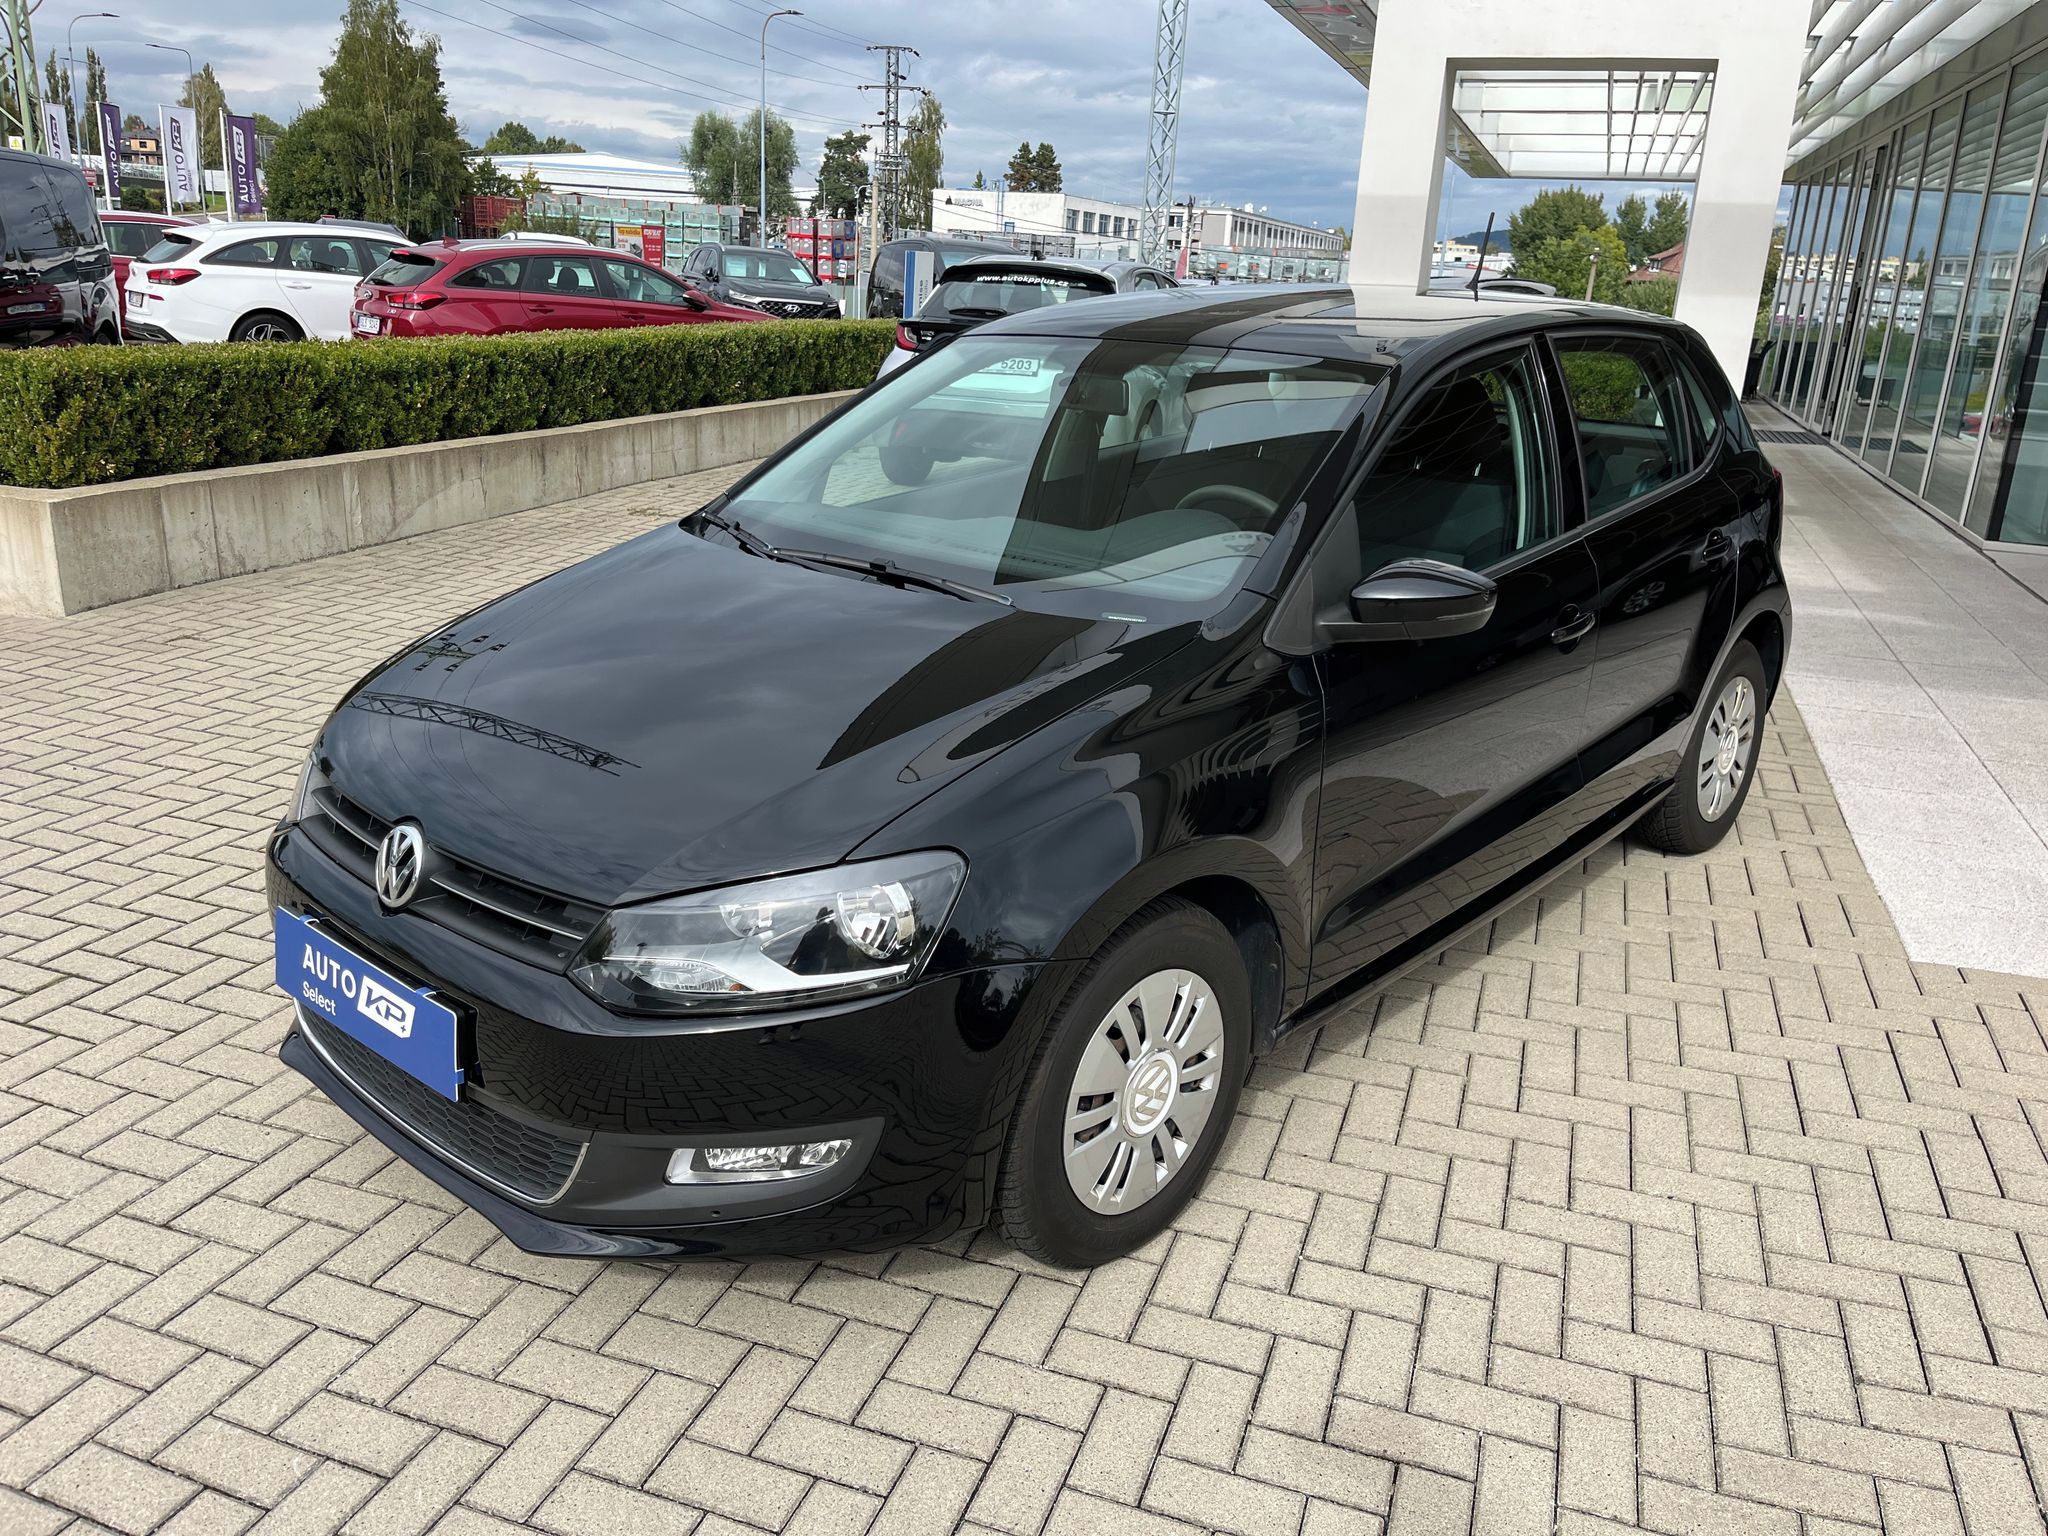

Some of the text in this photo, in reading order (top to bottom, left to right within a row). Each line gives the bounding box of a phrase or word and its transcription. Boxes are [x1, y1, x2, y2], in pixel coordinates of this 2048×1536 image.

[175, 155, 189, 192] AUTO
[238, 165, 249, 202] AUTO
[976, 275, 1069, 287] www.autokpplus.cz
[1001, 359, 1032, 370] 5203
[303, 944, 356, 999] AUTO
[303, 981, 336, 1016] Select
